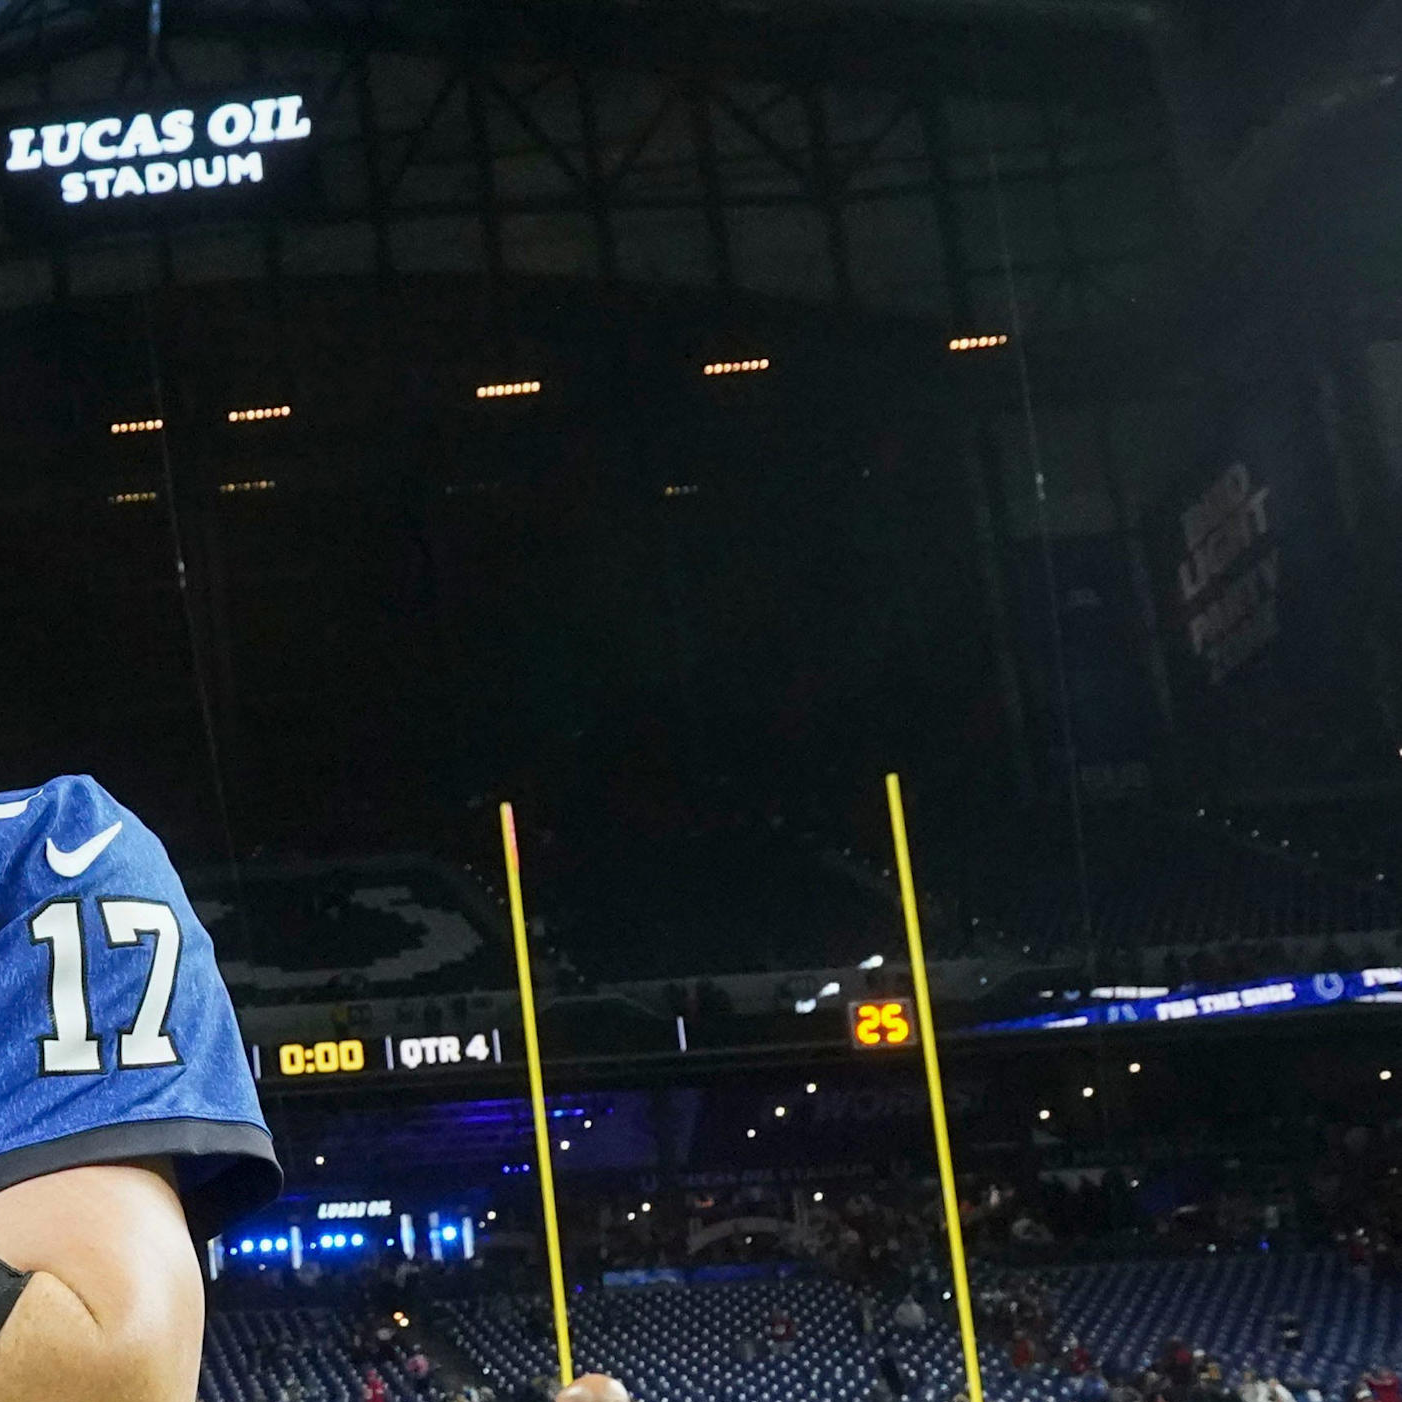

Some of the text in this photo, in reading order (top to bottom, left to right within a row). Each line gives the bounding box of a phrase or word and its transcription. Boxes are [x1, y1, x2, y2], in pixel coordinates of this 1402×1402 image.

[6, 95, 311, 171] LUCAS OIL
[61, 152, 263, 203] STADIUM
[32, 897, 183, 1077] 17
[1156, 999, 1197, 1021] FOR
[1198, 991, 1241, 1014] THE
[857, 1003, 909, 1045] 25
[280, 1039, 365, 1075] 0:00
[400, 1034, 490, 1069] QTR 4
